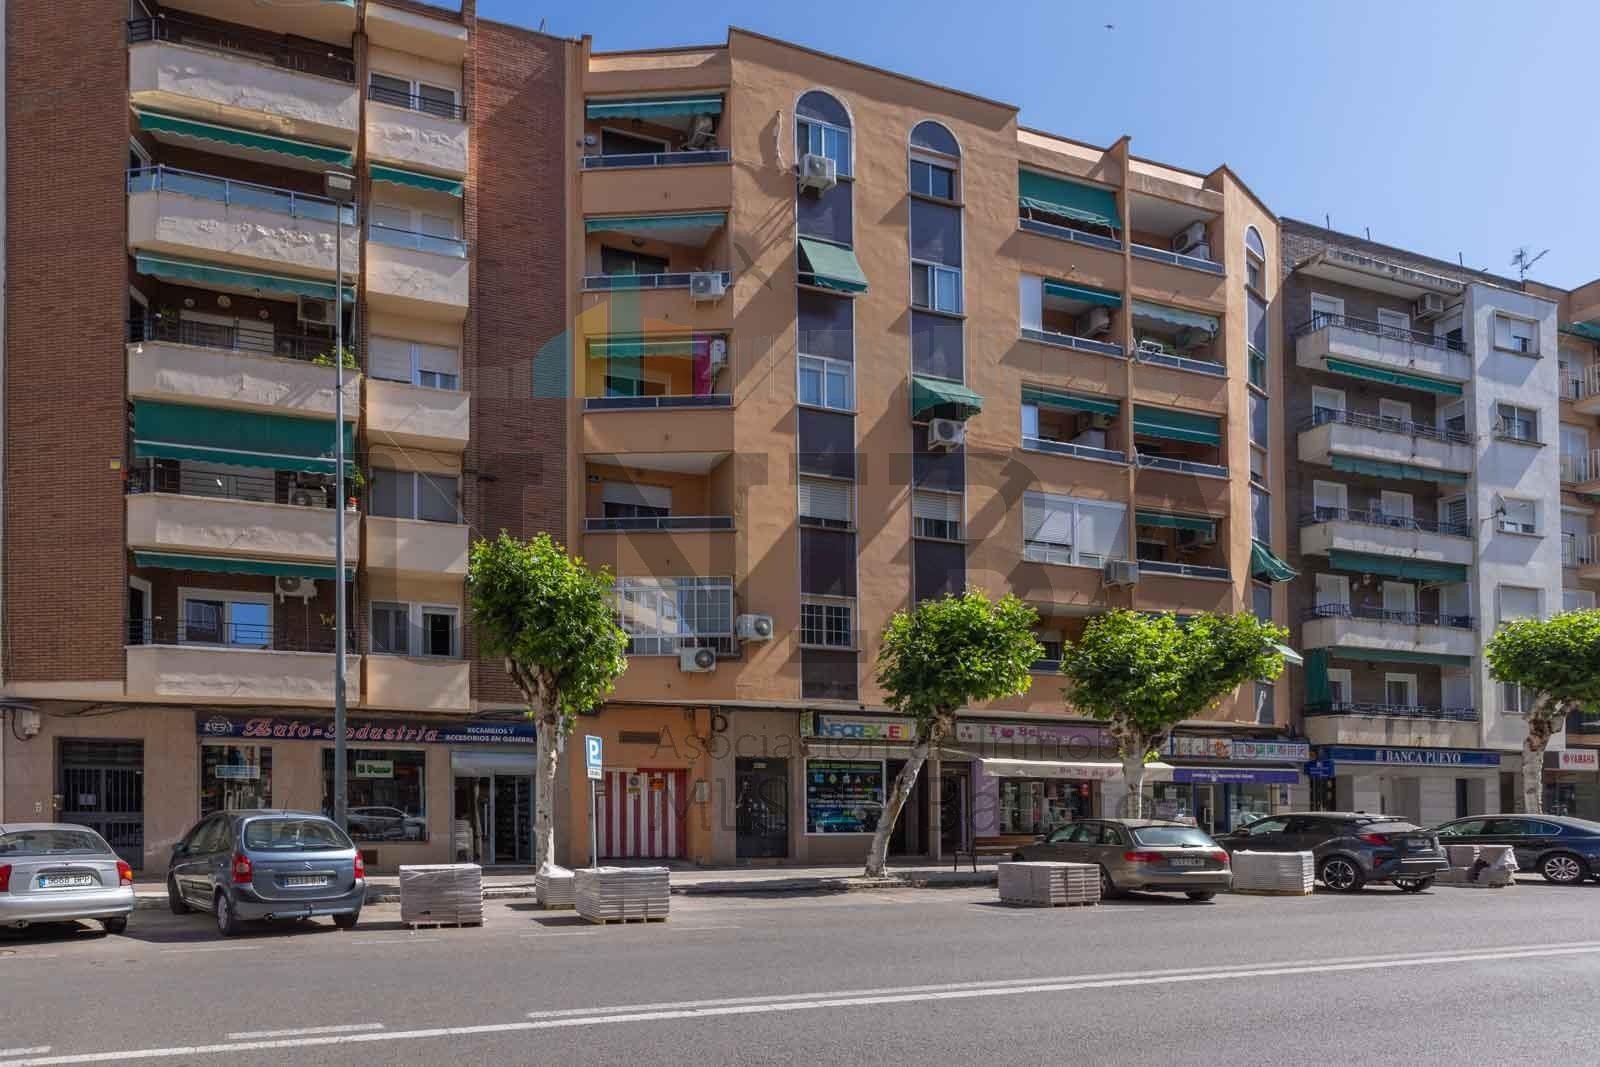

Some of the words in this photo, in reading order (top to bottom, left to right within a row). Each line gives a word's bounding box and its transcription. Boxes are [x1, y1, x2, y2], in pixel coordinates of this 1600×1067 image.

[589, 739, 600, 764] P
[1386, 750, 1423, 762] BANCA
[1426, 751, 1461, 763] PUEYO
